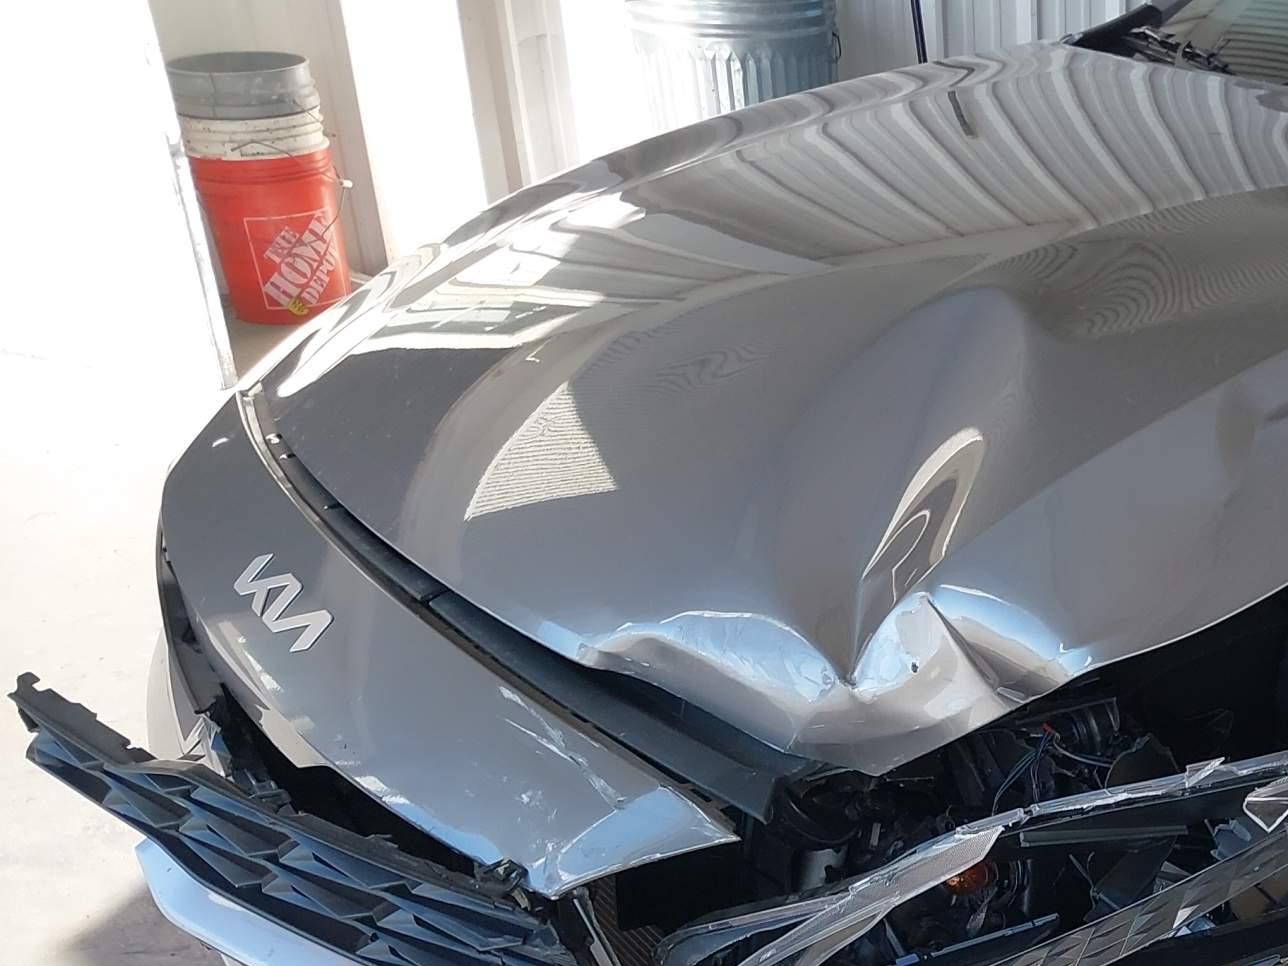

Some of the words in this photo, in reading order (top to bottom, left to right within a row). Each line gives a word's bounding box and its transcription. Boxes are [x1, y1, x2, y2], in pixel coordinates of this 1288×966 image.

[263, 225, 300, 264] THE
[263, 211, 332, 308] HOME
[233, 553, 334, 652] KIA
